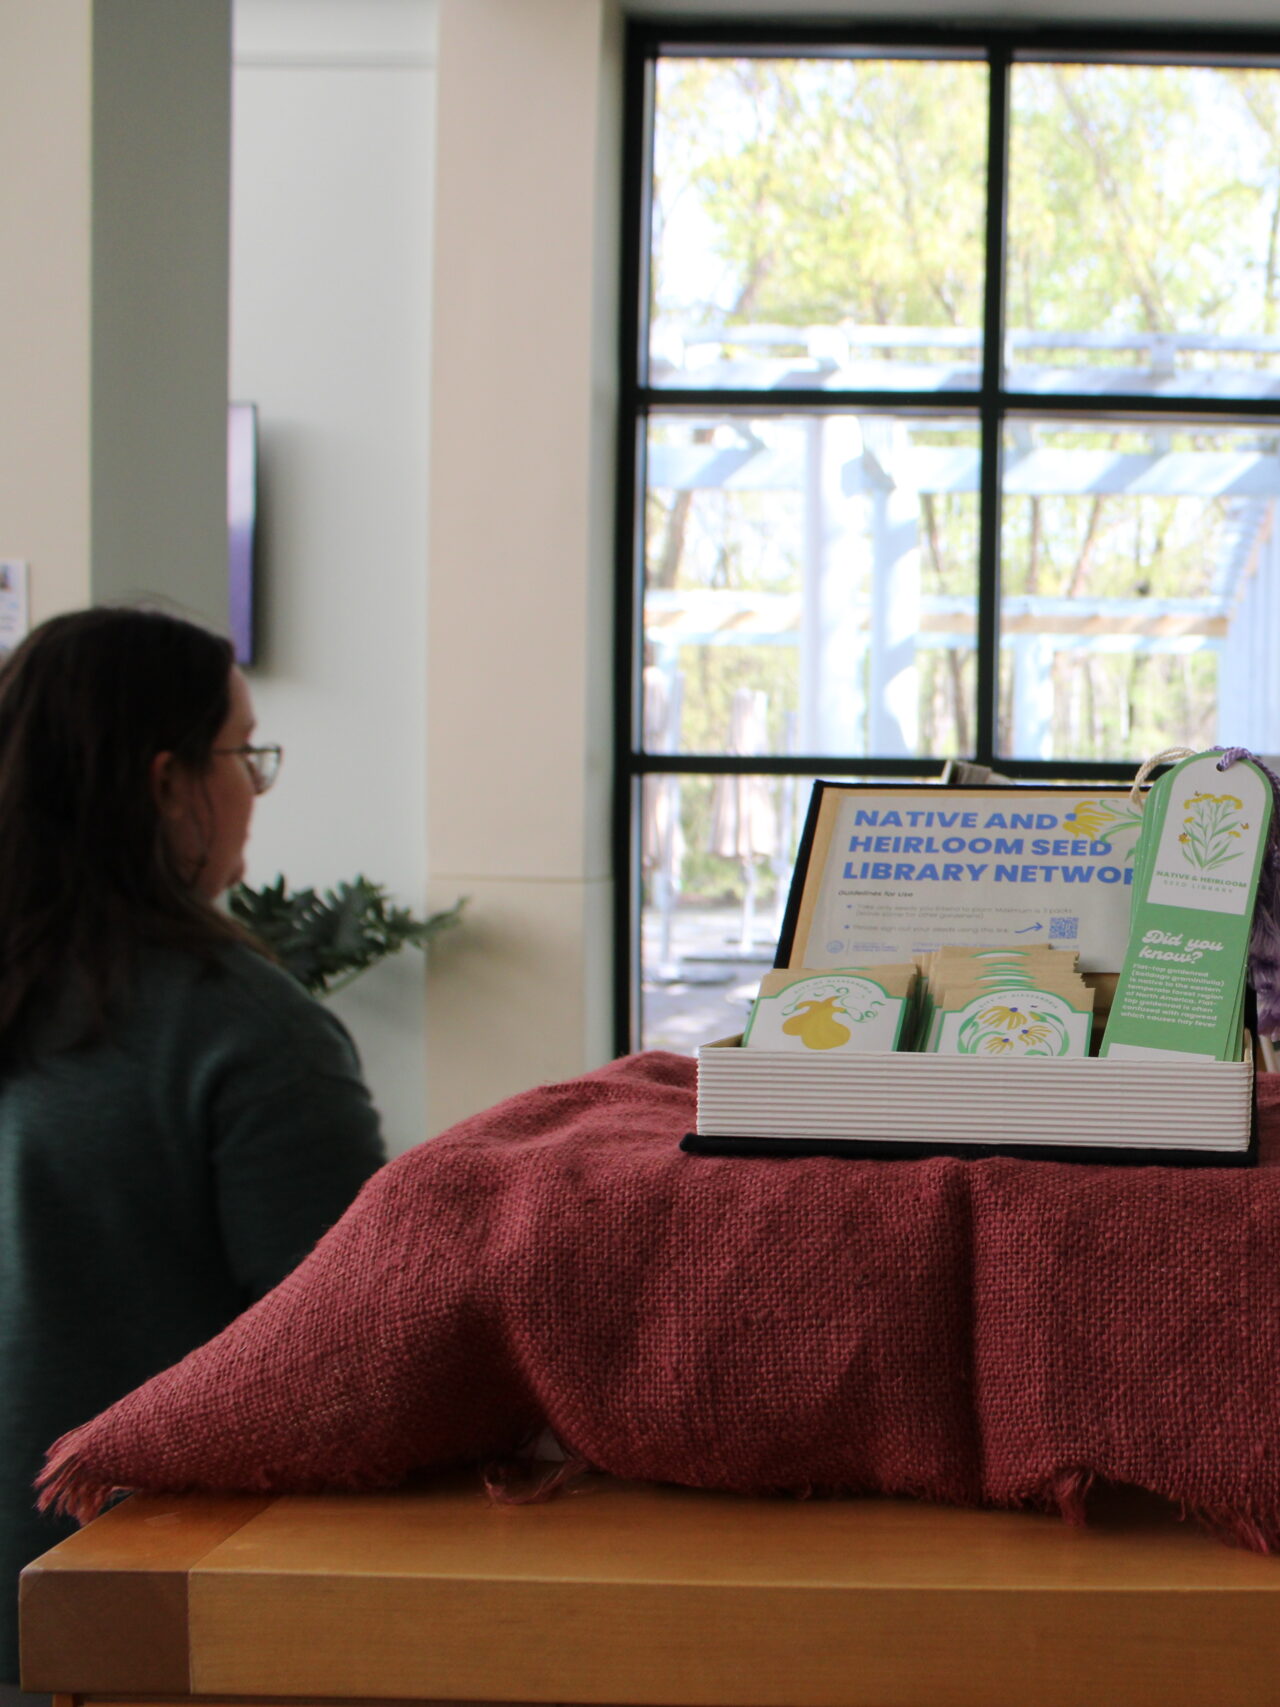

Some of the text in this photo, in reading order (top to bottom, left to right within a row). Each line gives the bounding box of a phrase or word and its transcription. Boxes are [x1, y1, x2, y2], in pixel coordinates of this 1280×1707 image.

[854, 810, 1058, 830] NATIVE AND
[848, 836, 1113, 857] HEIRLOOM SEED
[843, 862, 989, 882] LIBRARY
[1156, 870, 1189, 880] NATIVE
[1200, 876, 1247, 888] HEIRLOOM
[1142, 929, 1224, 952] Did you
[1138, 945, 1203, 964] know?
